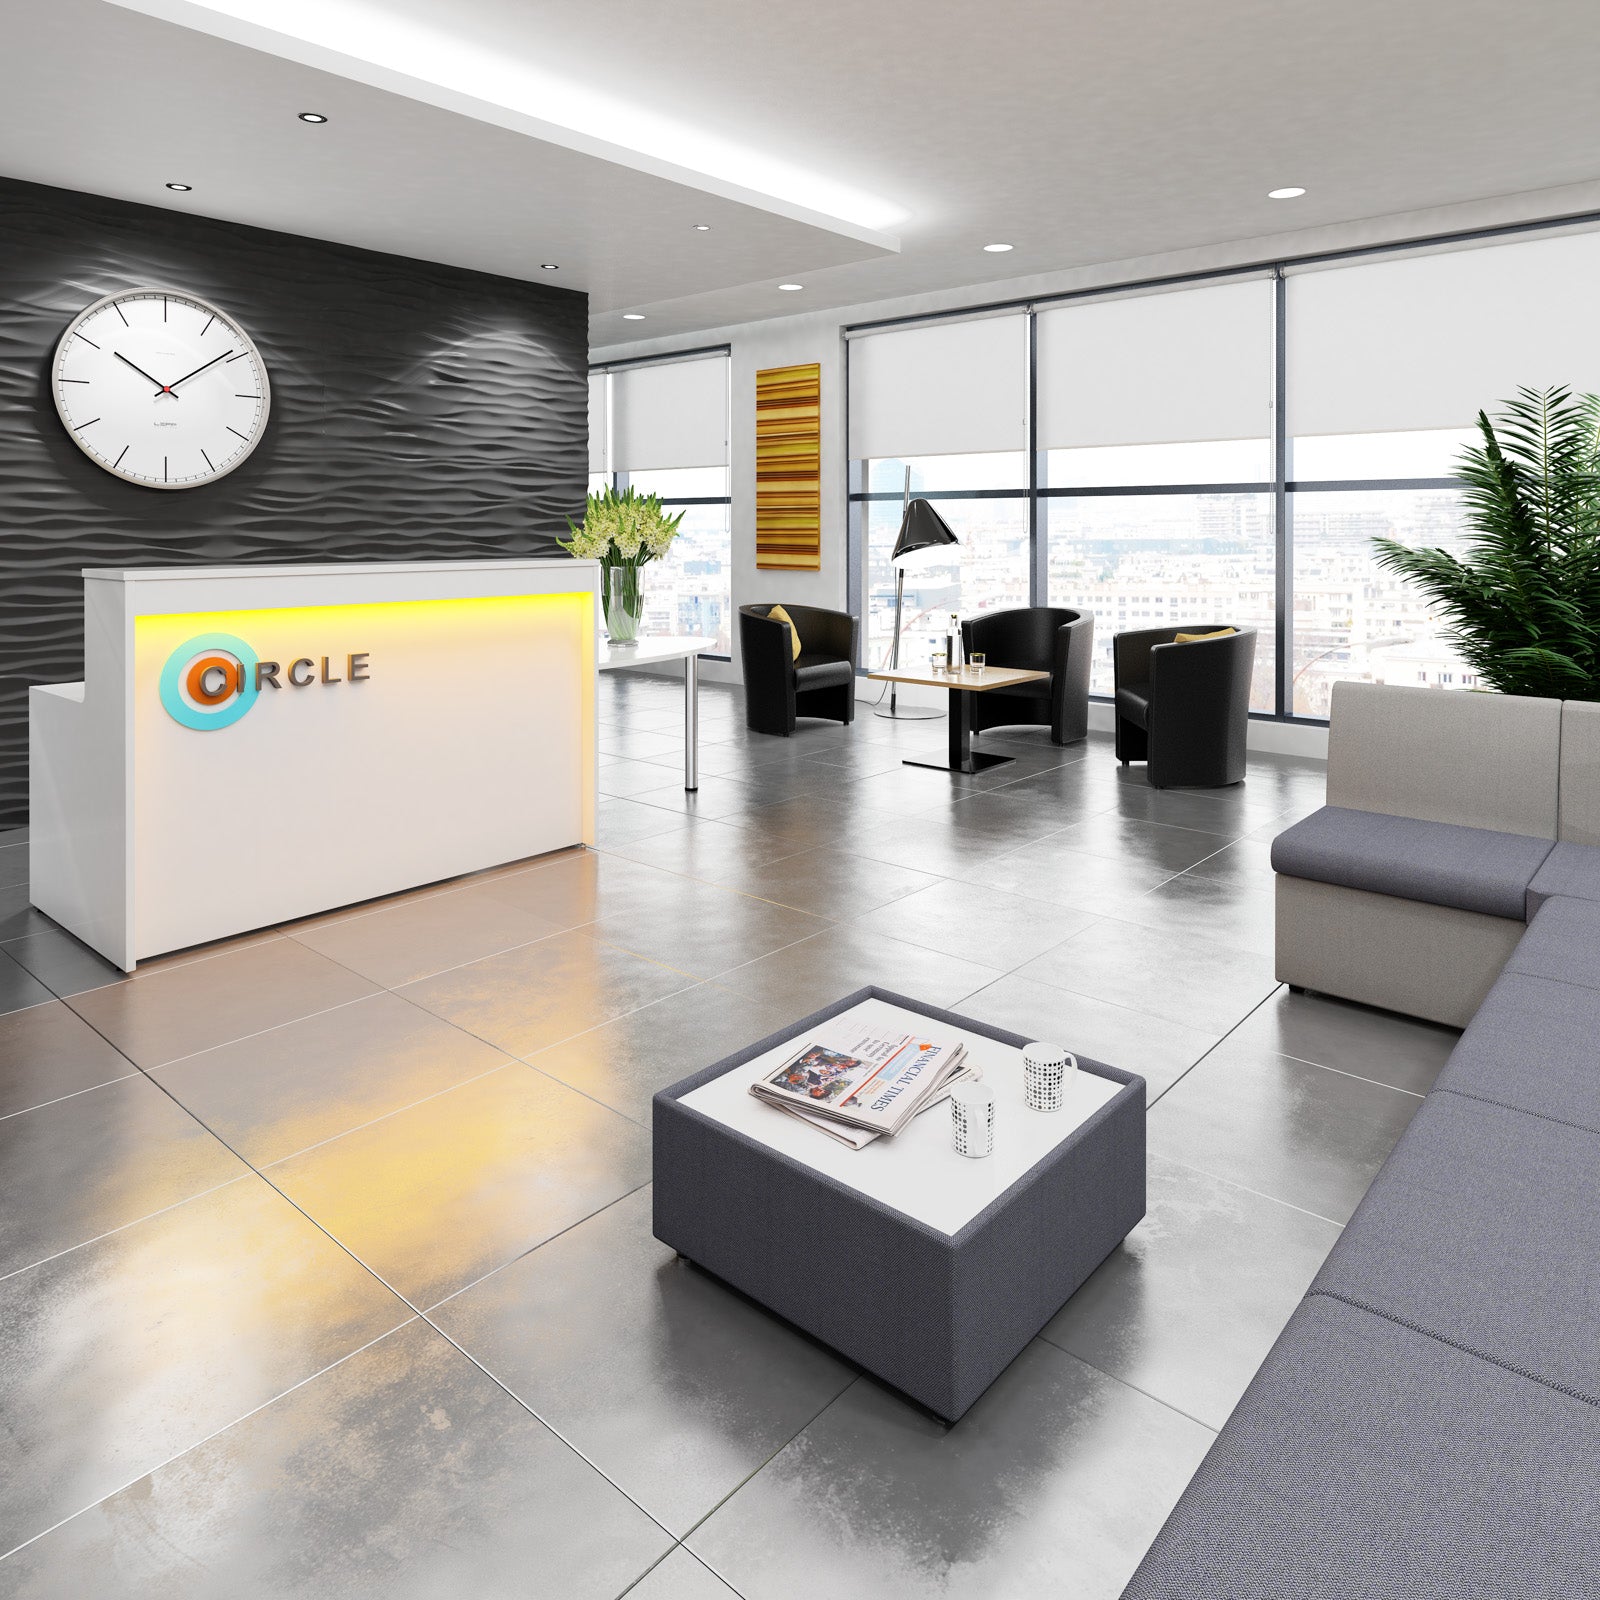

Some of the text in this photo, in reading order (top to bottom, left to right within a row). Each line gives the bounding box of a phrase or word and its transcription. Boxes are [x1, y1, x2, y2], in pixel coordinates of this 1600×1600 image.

[199, 652, 370, 697] CIRCLE
[897, 1046, 942, 1085] FINANCIAL
[870, 1086, 904, 1111] TIMES
